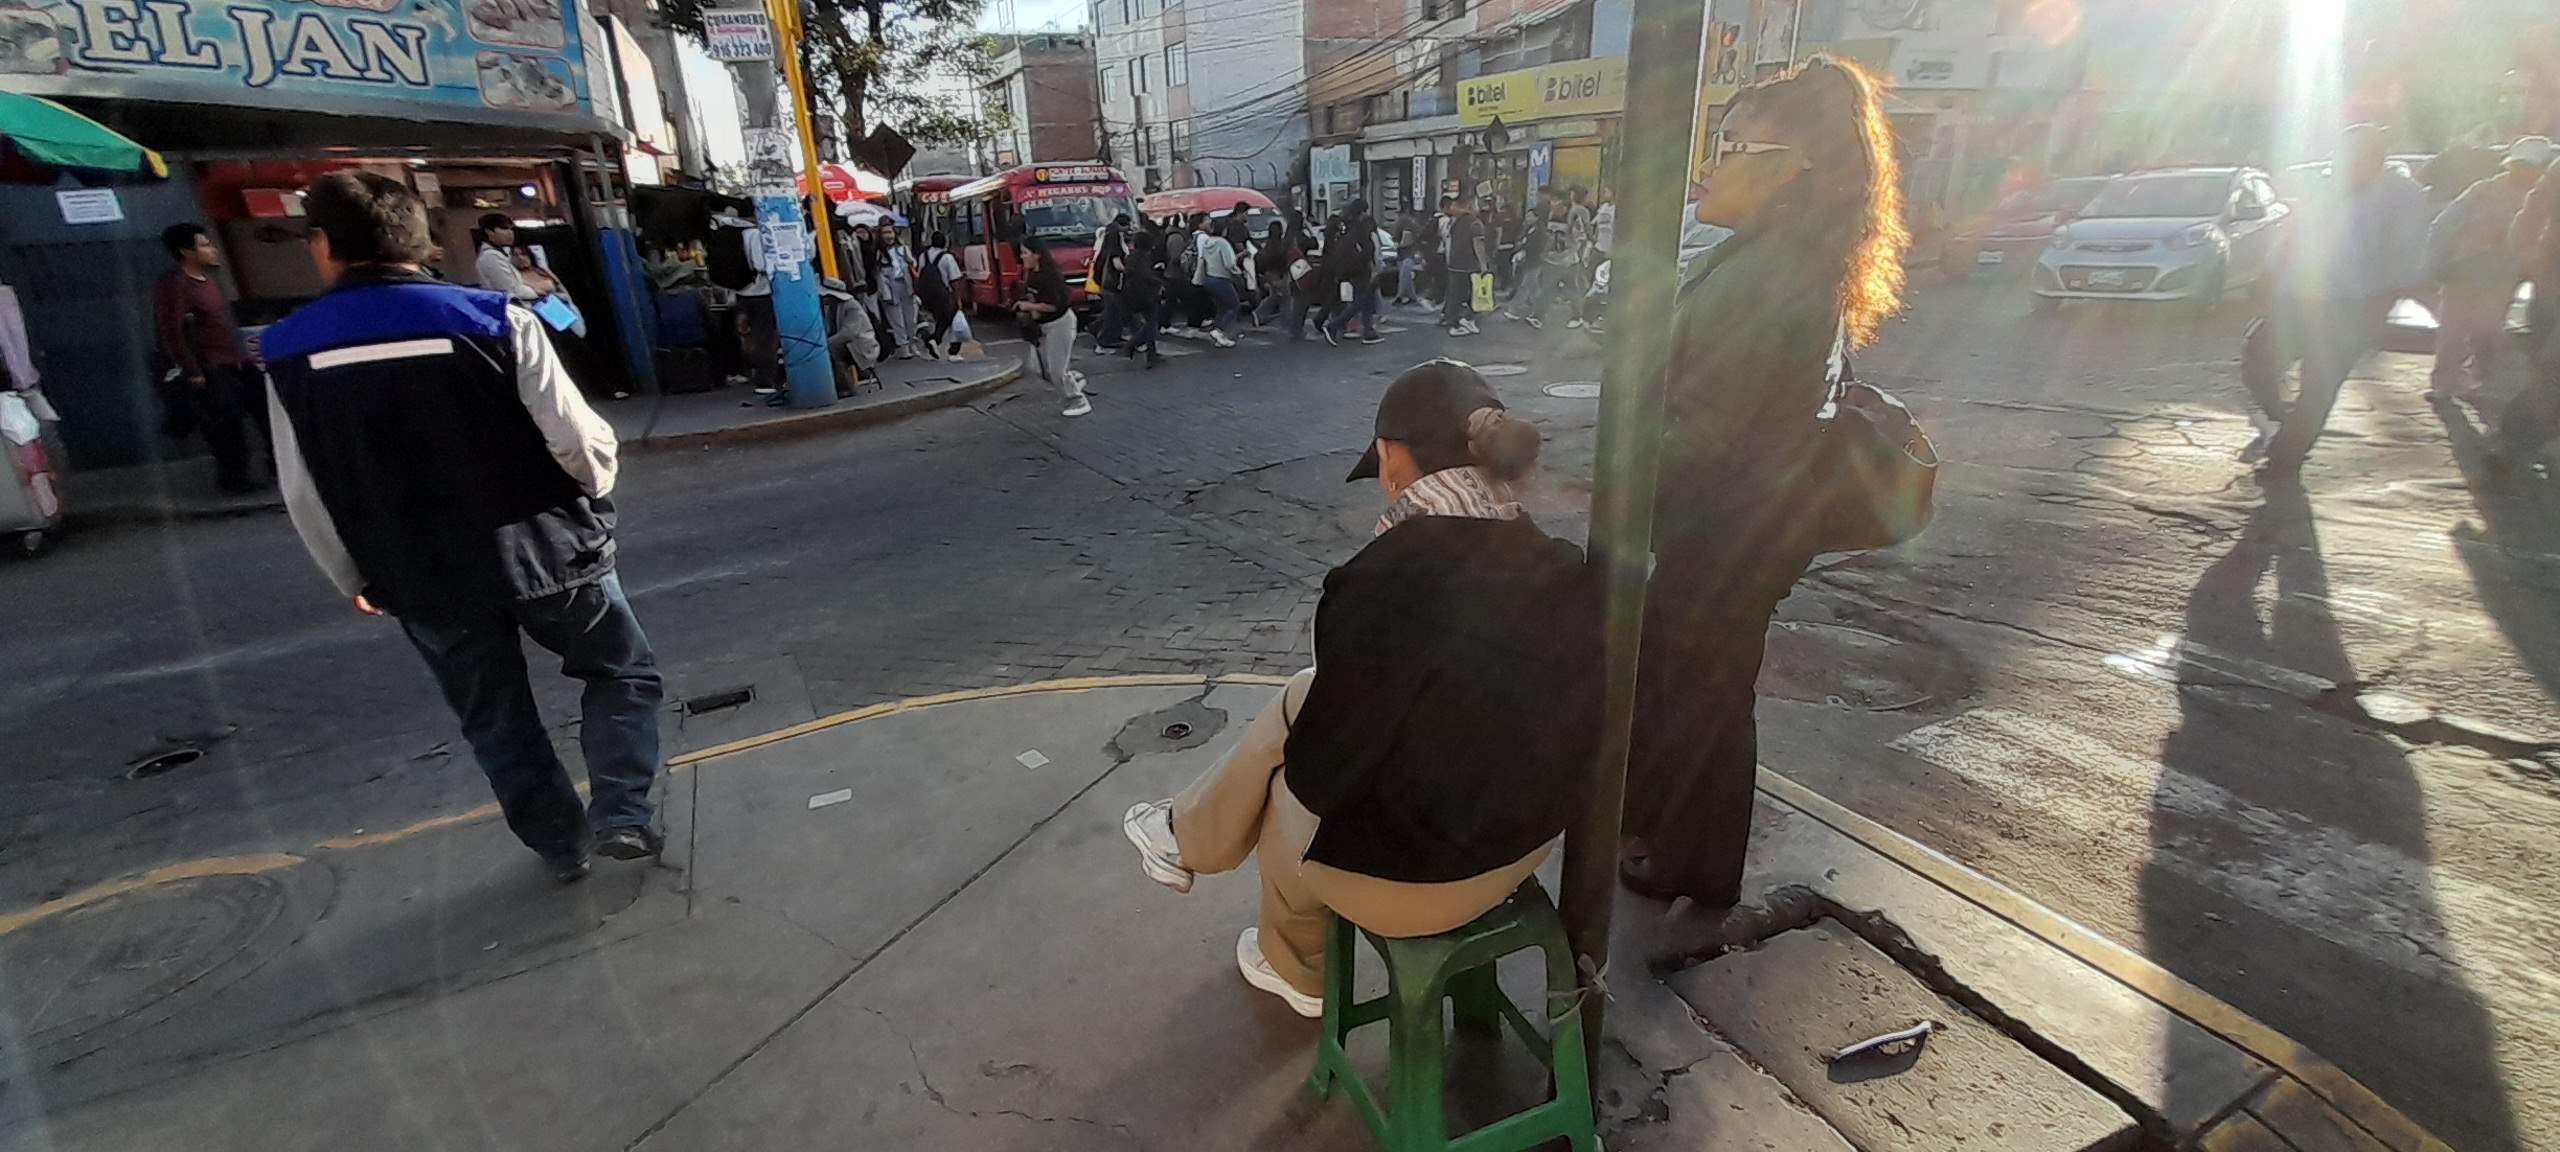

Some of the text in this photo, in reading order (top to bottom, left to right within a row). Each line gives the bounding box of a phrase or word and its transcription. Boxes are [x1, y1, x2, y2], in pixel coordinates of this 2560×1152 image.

[78, 0, 431, 88] EL JAN
[1477, 82, 1506, 105] bitel
[1559, 71, 1602, 101] bitel
